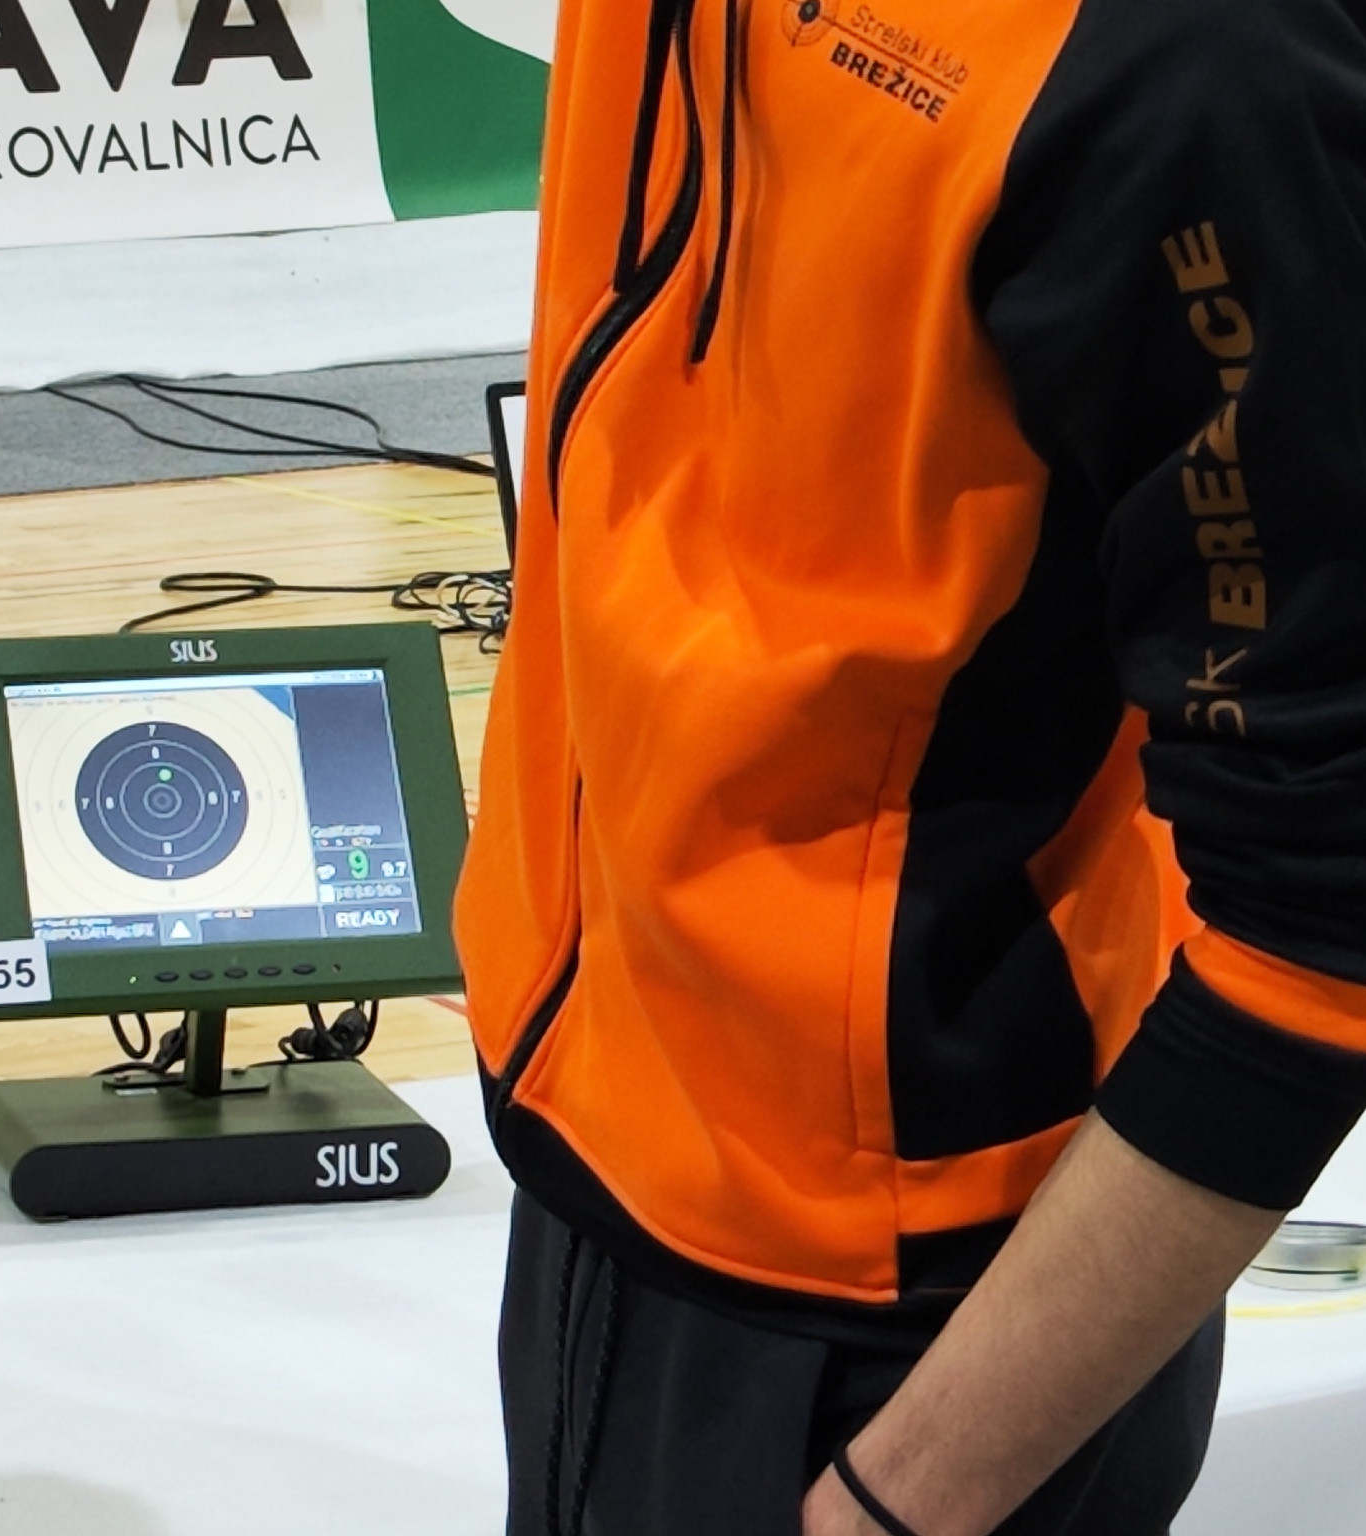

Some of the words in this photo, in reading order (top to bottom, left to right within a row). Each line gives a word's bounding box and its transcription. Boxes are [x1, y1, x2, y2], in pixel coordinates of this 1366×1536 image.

[830, 40, 947, 122] BREŽICE
[170, 639, 218, 662] SIUS
[348, 850, 369, 879] 9
[316, 1141, 400, 1188] SIUS
